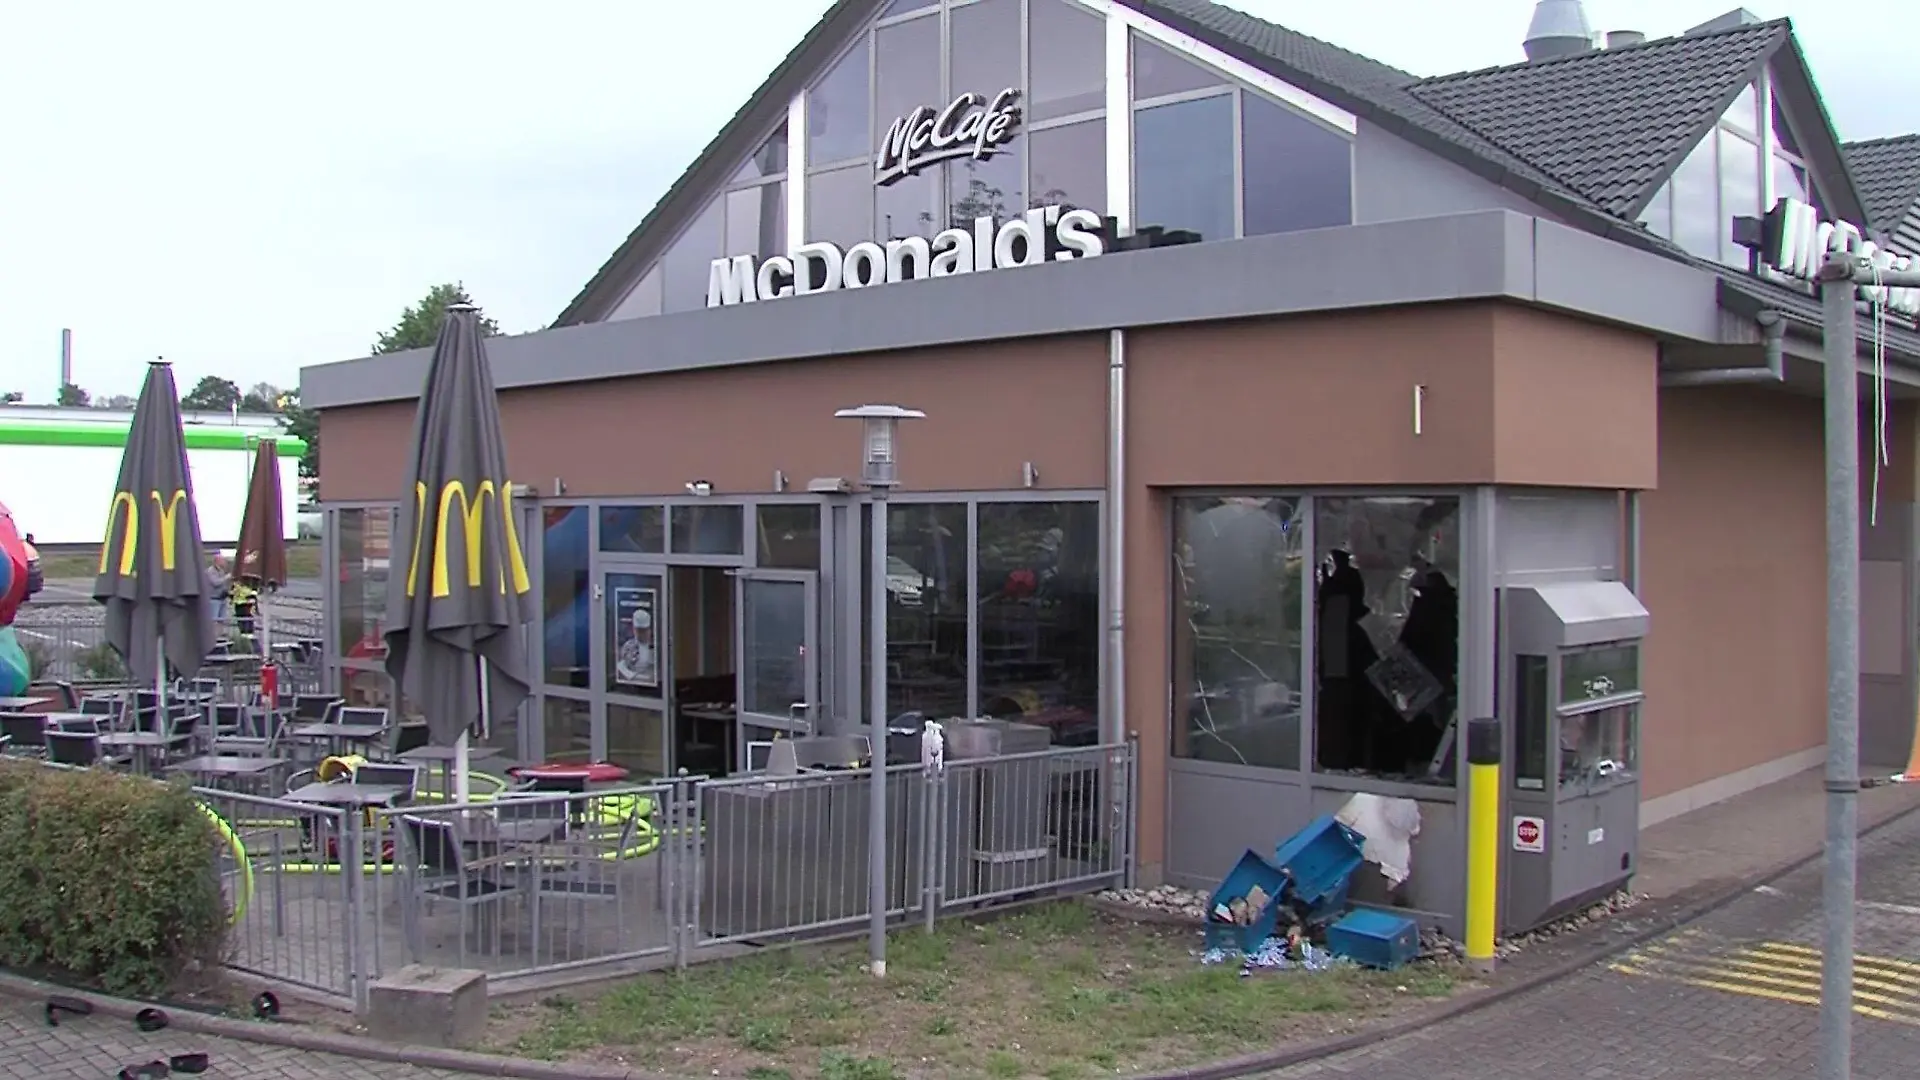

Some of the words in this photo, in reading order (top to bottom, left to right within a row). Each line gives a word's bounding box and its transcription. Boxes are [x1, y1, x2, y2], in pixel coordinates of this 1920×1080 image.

[876, 86, 1015, 174] McCafé
[707, 205, 1102, 308] McDonald's
[1518, 826, 1538, 837] STOP
